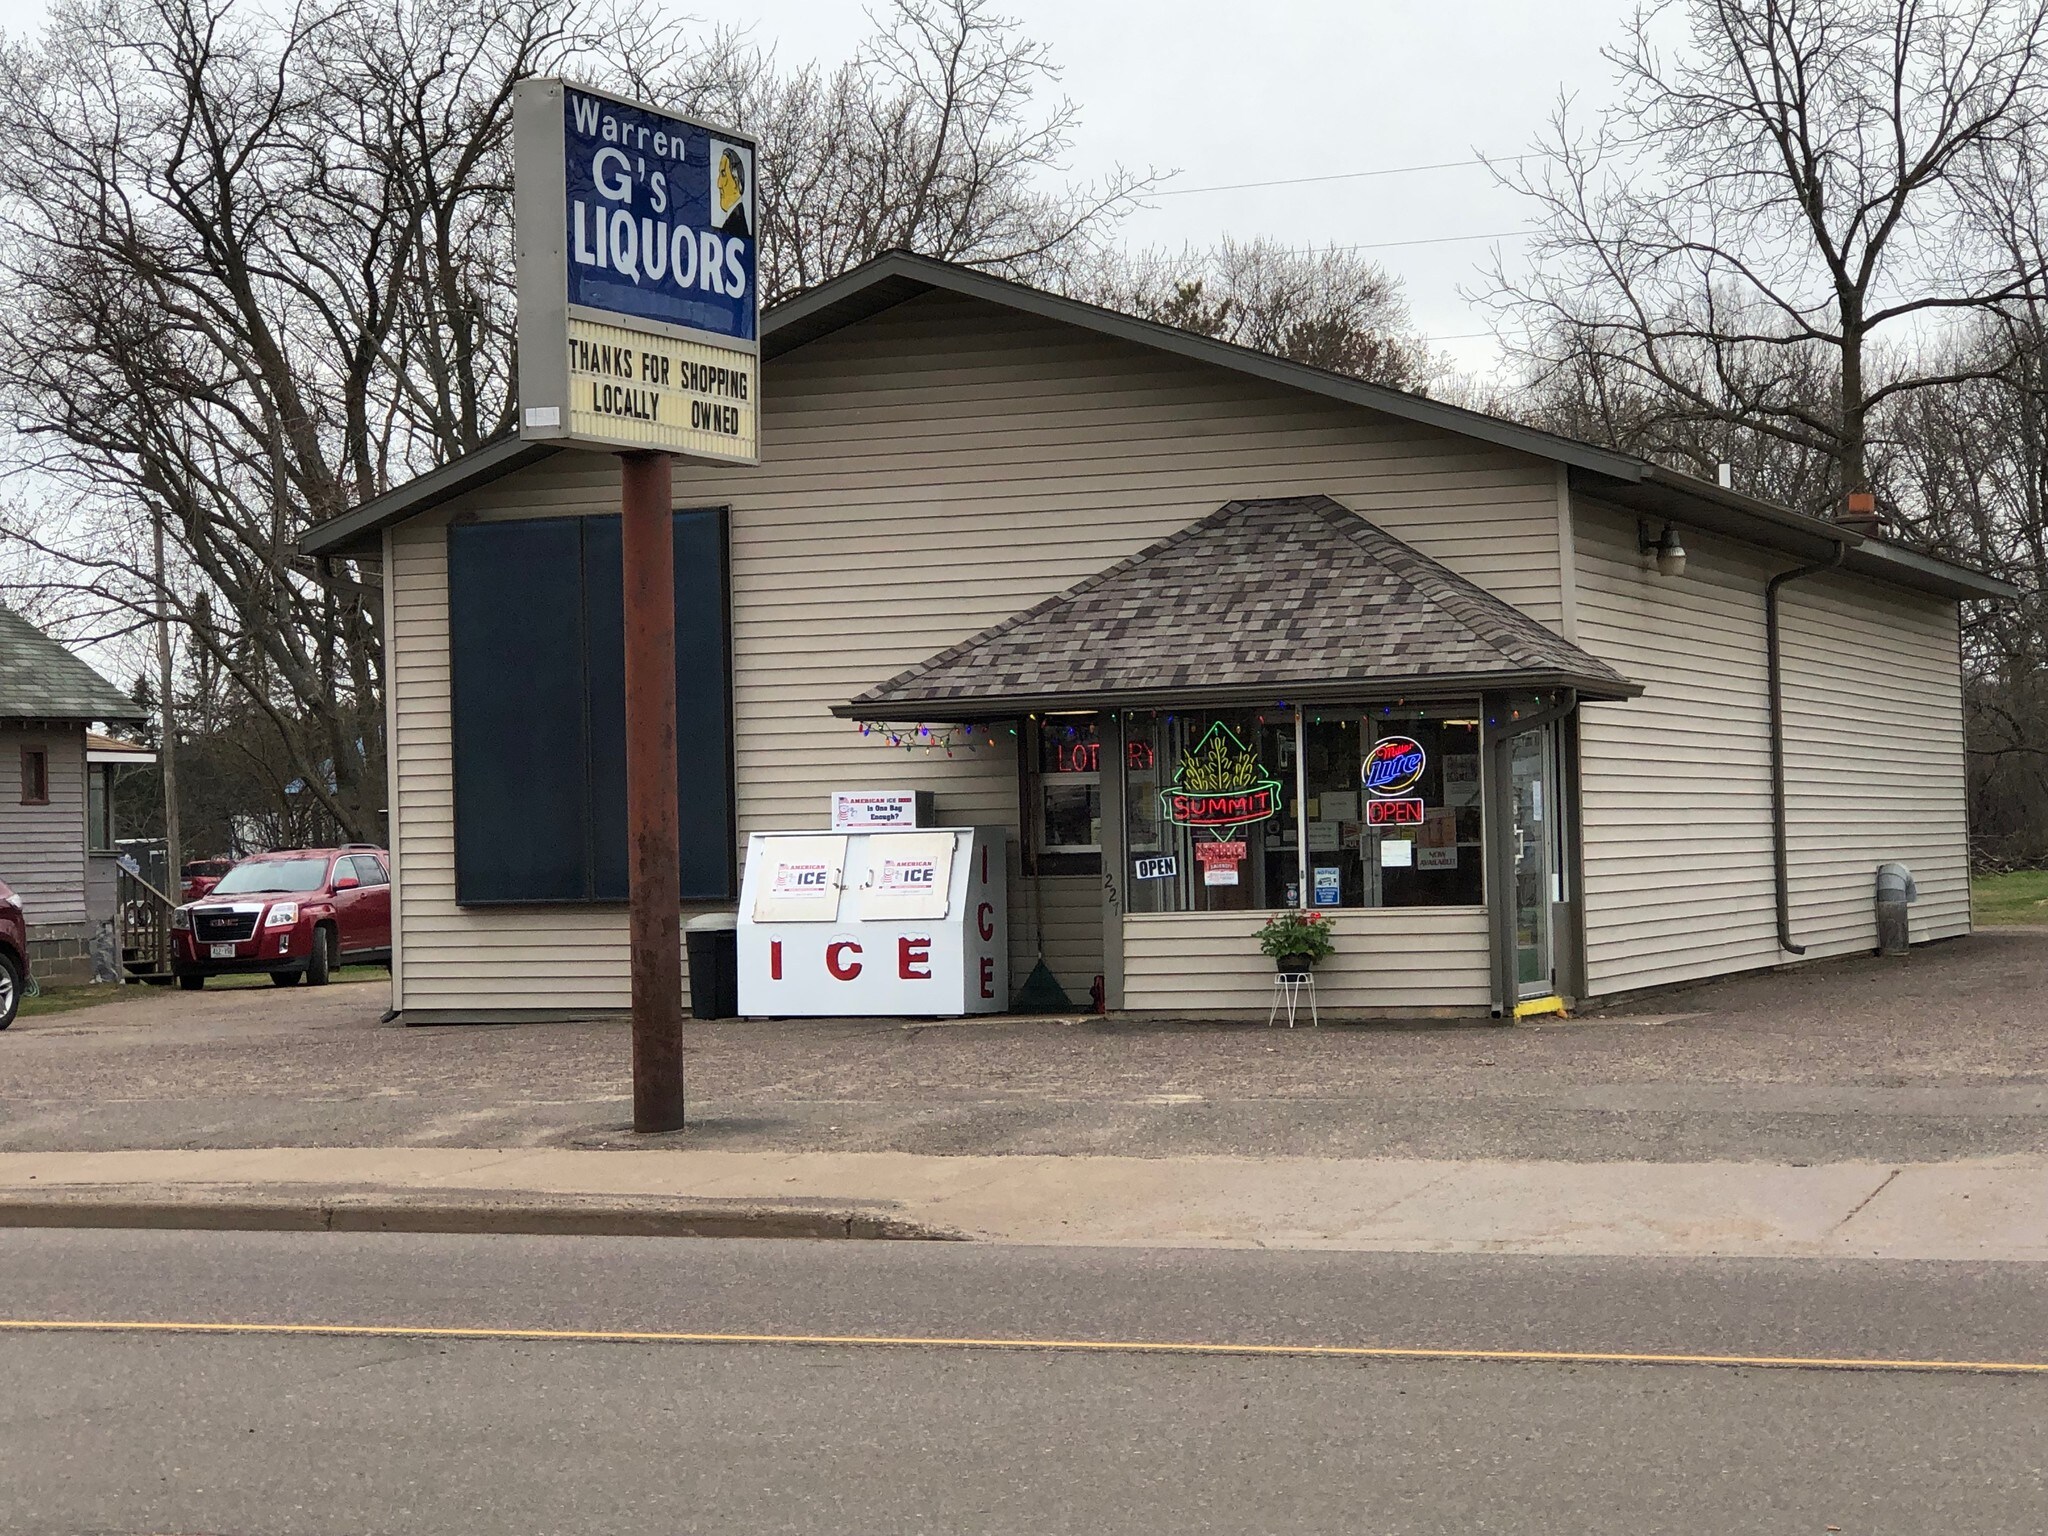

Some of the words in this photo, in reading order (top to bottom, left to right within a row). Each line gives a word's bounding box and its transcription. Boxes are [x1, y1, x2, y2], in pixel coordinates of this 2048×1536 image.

[572, 94, 686, 161] Warren
[592, 146, 667, 213] G's
[574, 200, 746, 299] LIQUORS
[569, 338, 633, 379] THANKS
[642, 352, 670, 386] FOR
[681, 361, 748, 401] SHOPPING
[593, 380, 660, 422] LOCALLY
[691, 399, 739, 436] OWNED
[1058, 742, 1154, 771] LOTRY
[1366, 753, 1422, 787] Lite
[870, 813, 900, 821] Enough?
[889, 804, 903, 813] Bag
[1172, 791, 1270, 820] SUMMIT
[1370, 801, 1421, 823] OPEN
[797, 871, 827, 885] ICE
[903, 868, 933, 882] ICE
[1139, 858, 1174, 877] OPEN
[977, 844, 995, 998] ICE
[770, 932, 932, 981] ICE
